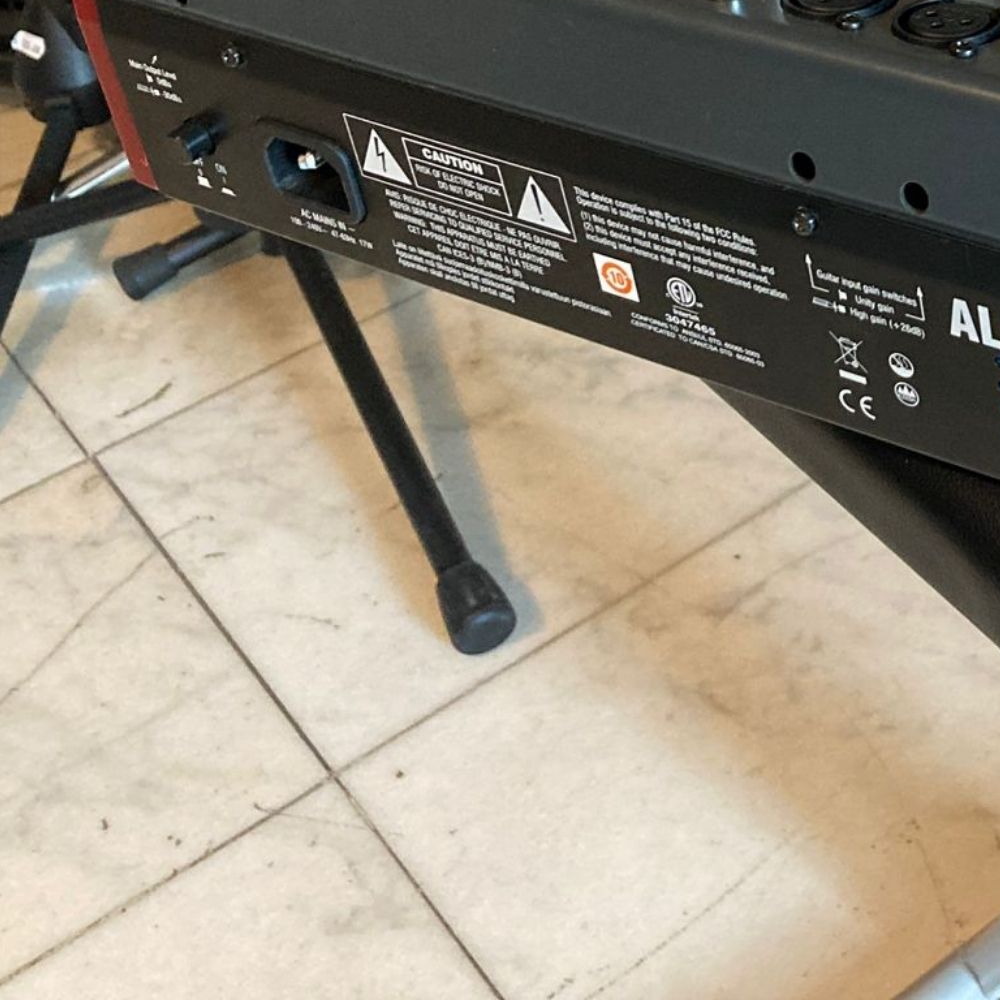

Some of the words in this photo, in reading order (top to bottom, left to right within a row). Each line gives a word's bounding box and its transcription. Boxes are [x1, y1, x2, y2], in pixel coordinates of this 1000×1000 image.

[415, 164, 432, 175] RISK
[422, 148, 484, 175] CAUTION
[438, 180, 448, 190] DO
[448, 184, 463, 194] NOT
[464, 189, 484, 201] OPEN
[816, 268, 840, 284] Guitar
[841, 278, 862, 291] input
[863, 284, 880, 296] gain
[854, 294, 876, 310] Unity
[877, 303, 895, 315] gain
[665, 312, 716, 336] 3047465
[849, 307, 869, 321] High
[870, 313, 888, 326] gain
